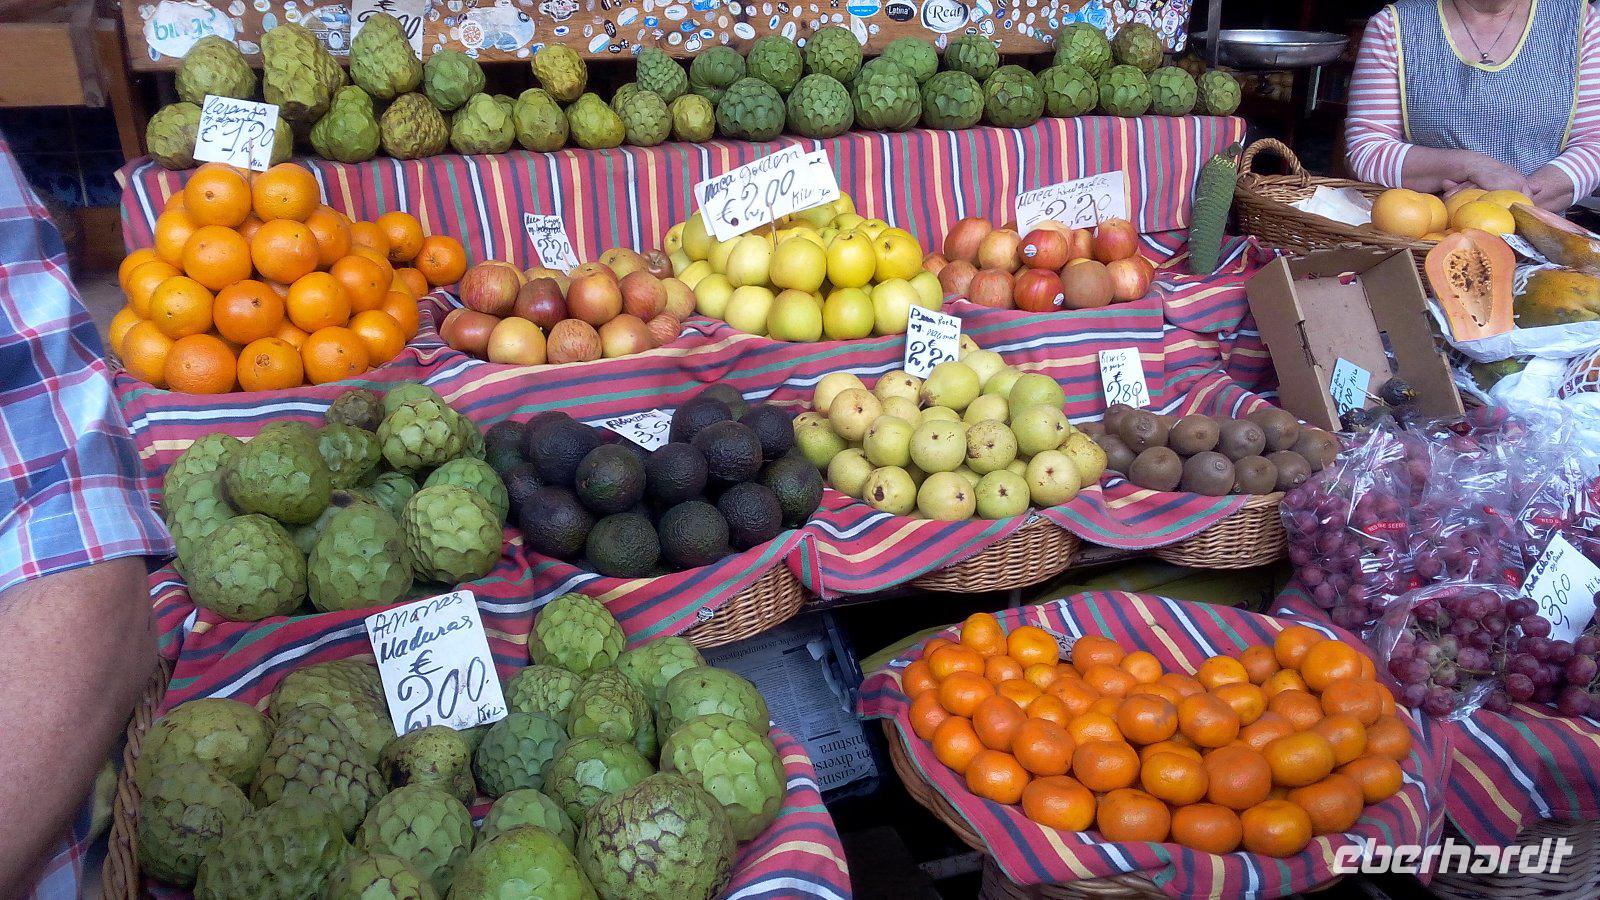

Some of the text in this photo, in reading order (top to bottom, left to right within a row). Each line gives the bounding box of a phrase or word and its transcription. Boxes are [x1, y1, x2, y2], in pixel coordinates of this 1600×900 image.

[889, 6, 909, 15] Latina
[929, 5, 963, 23] Real
[380, 615, 474, 664] Maduras
[408, 649, 444, 676] €
